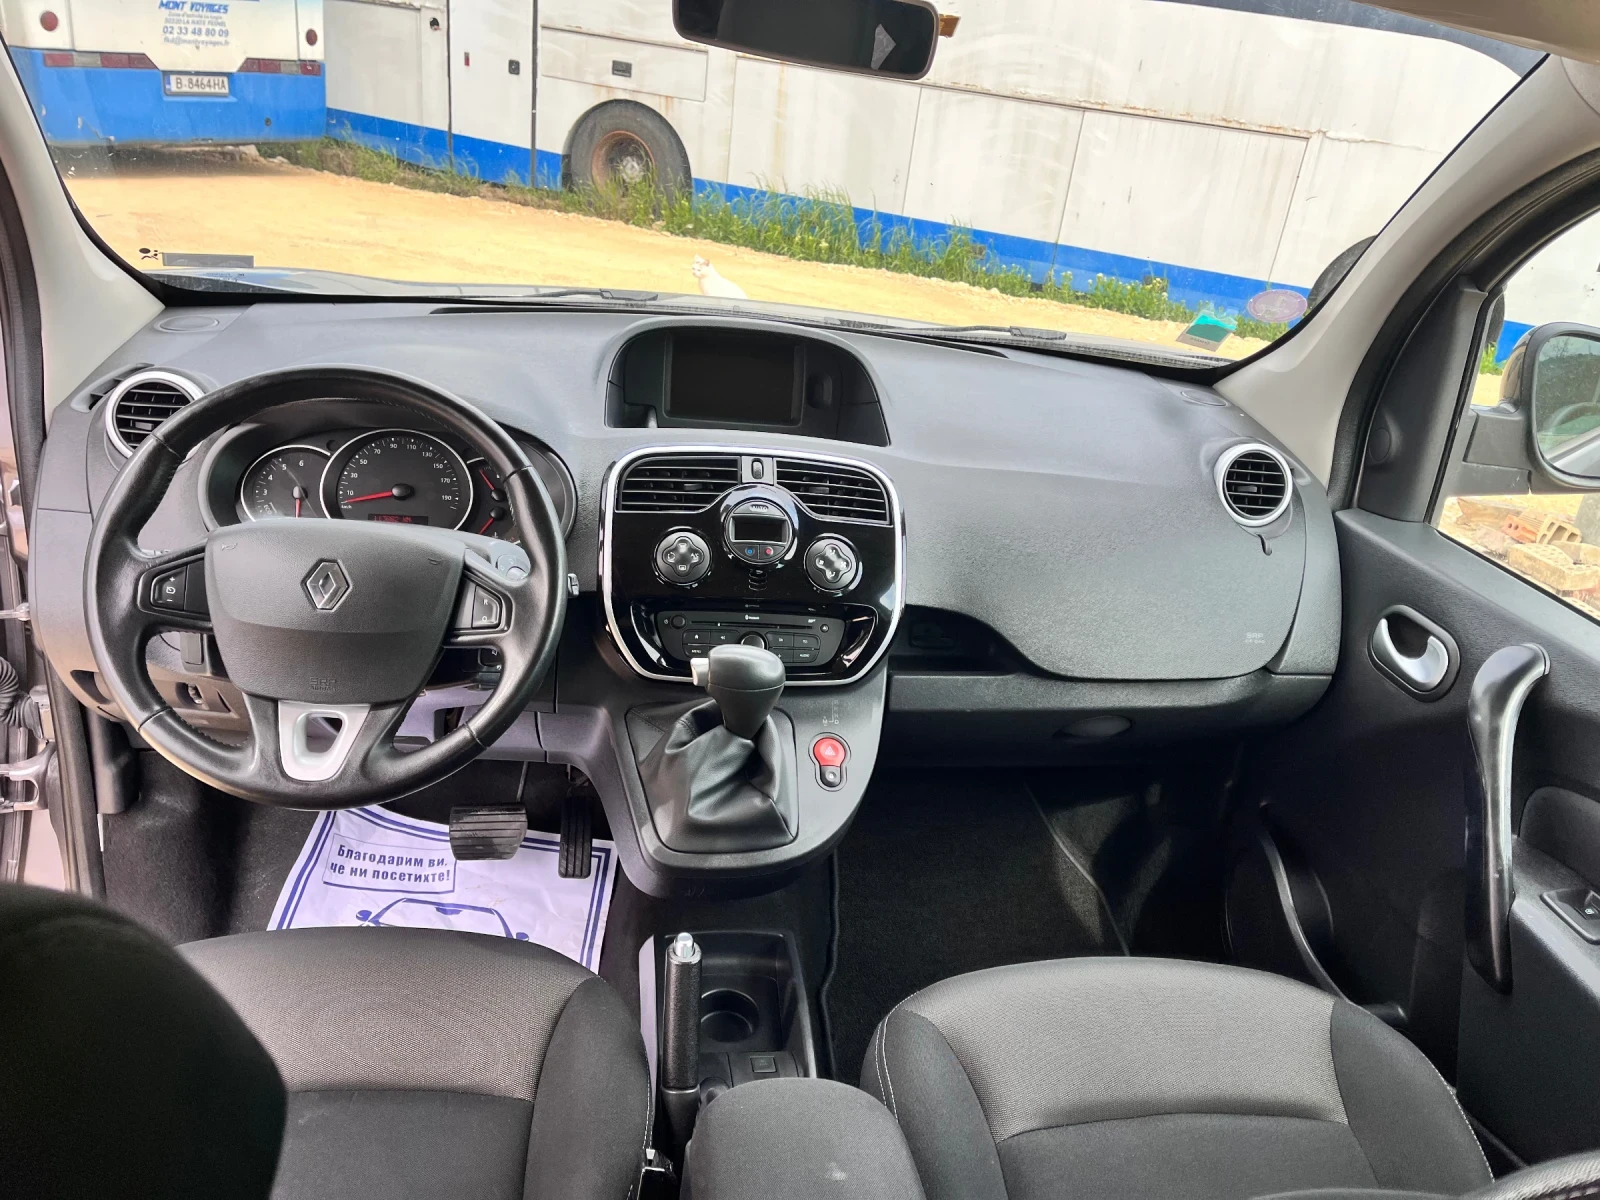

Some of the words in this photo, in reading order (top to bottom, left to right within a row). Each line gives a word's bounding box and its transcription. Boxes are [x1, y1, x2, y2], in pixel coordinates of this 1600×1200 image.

[158, 0, 187, 11] MONT
[190, 2, 229, 14] VOYAGES
[162, 25, 174, 34] 02
[177, 26, 188, 35] 33
[191, 27, 202, 36] 48
[205, 28, 216, 37] 80
[218, 29, 229, 38] 09
[282, 463, 287, 471] 5
[337, 844, 424, 867] Благодарим
[330, 862, 345, 875] че
[349, 867, 368, 878] ни
[372, 869, 451, 883] посетихте!
